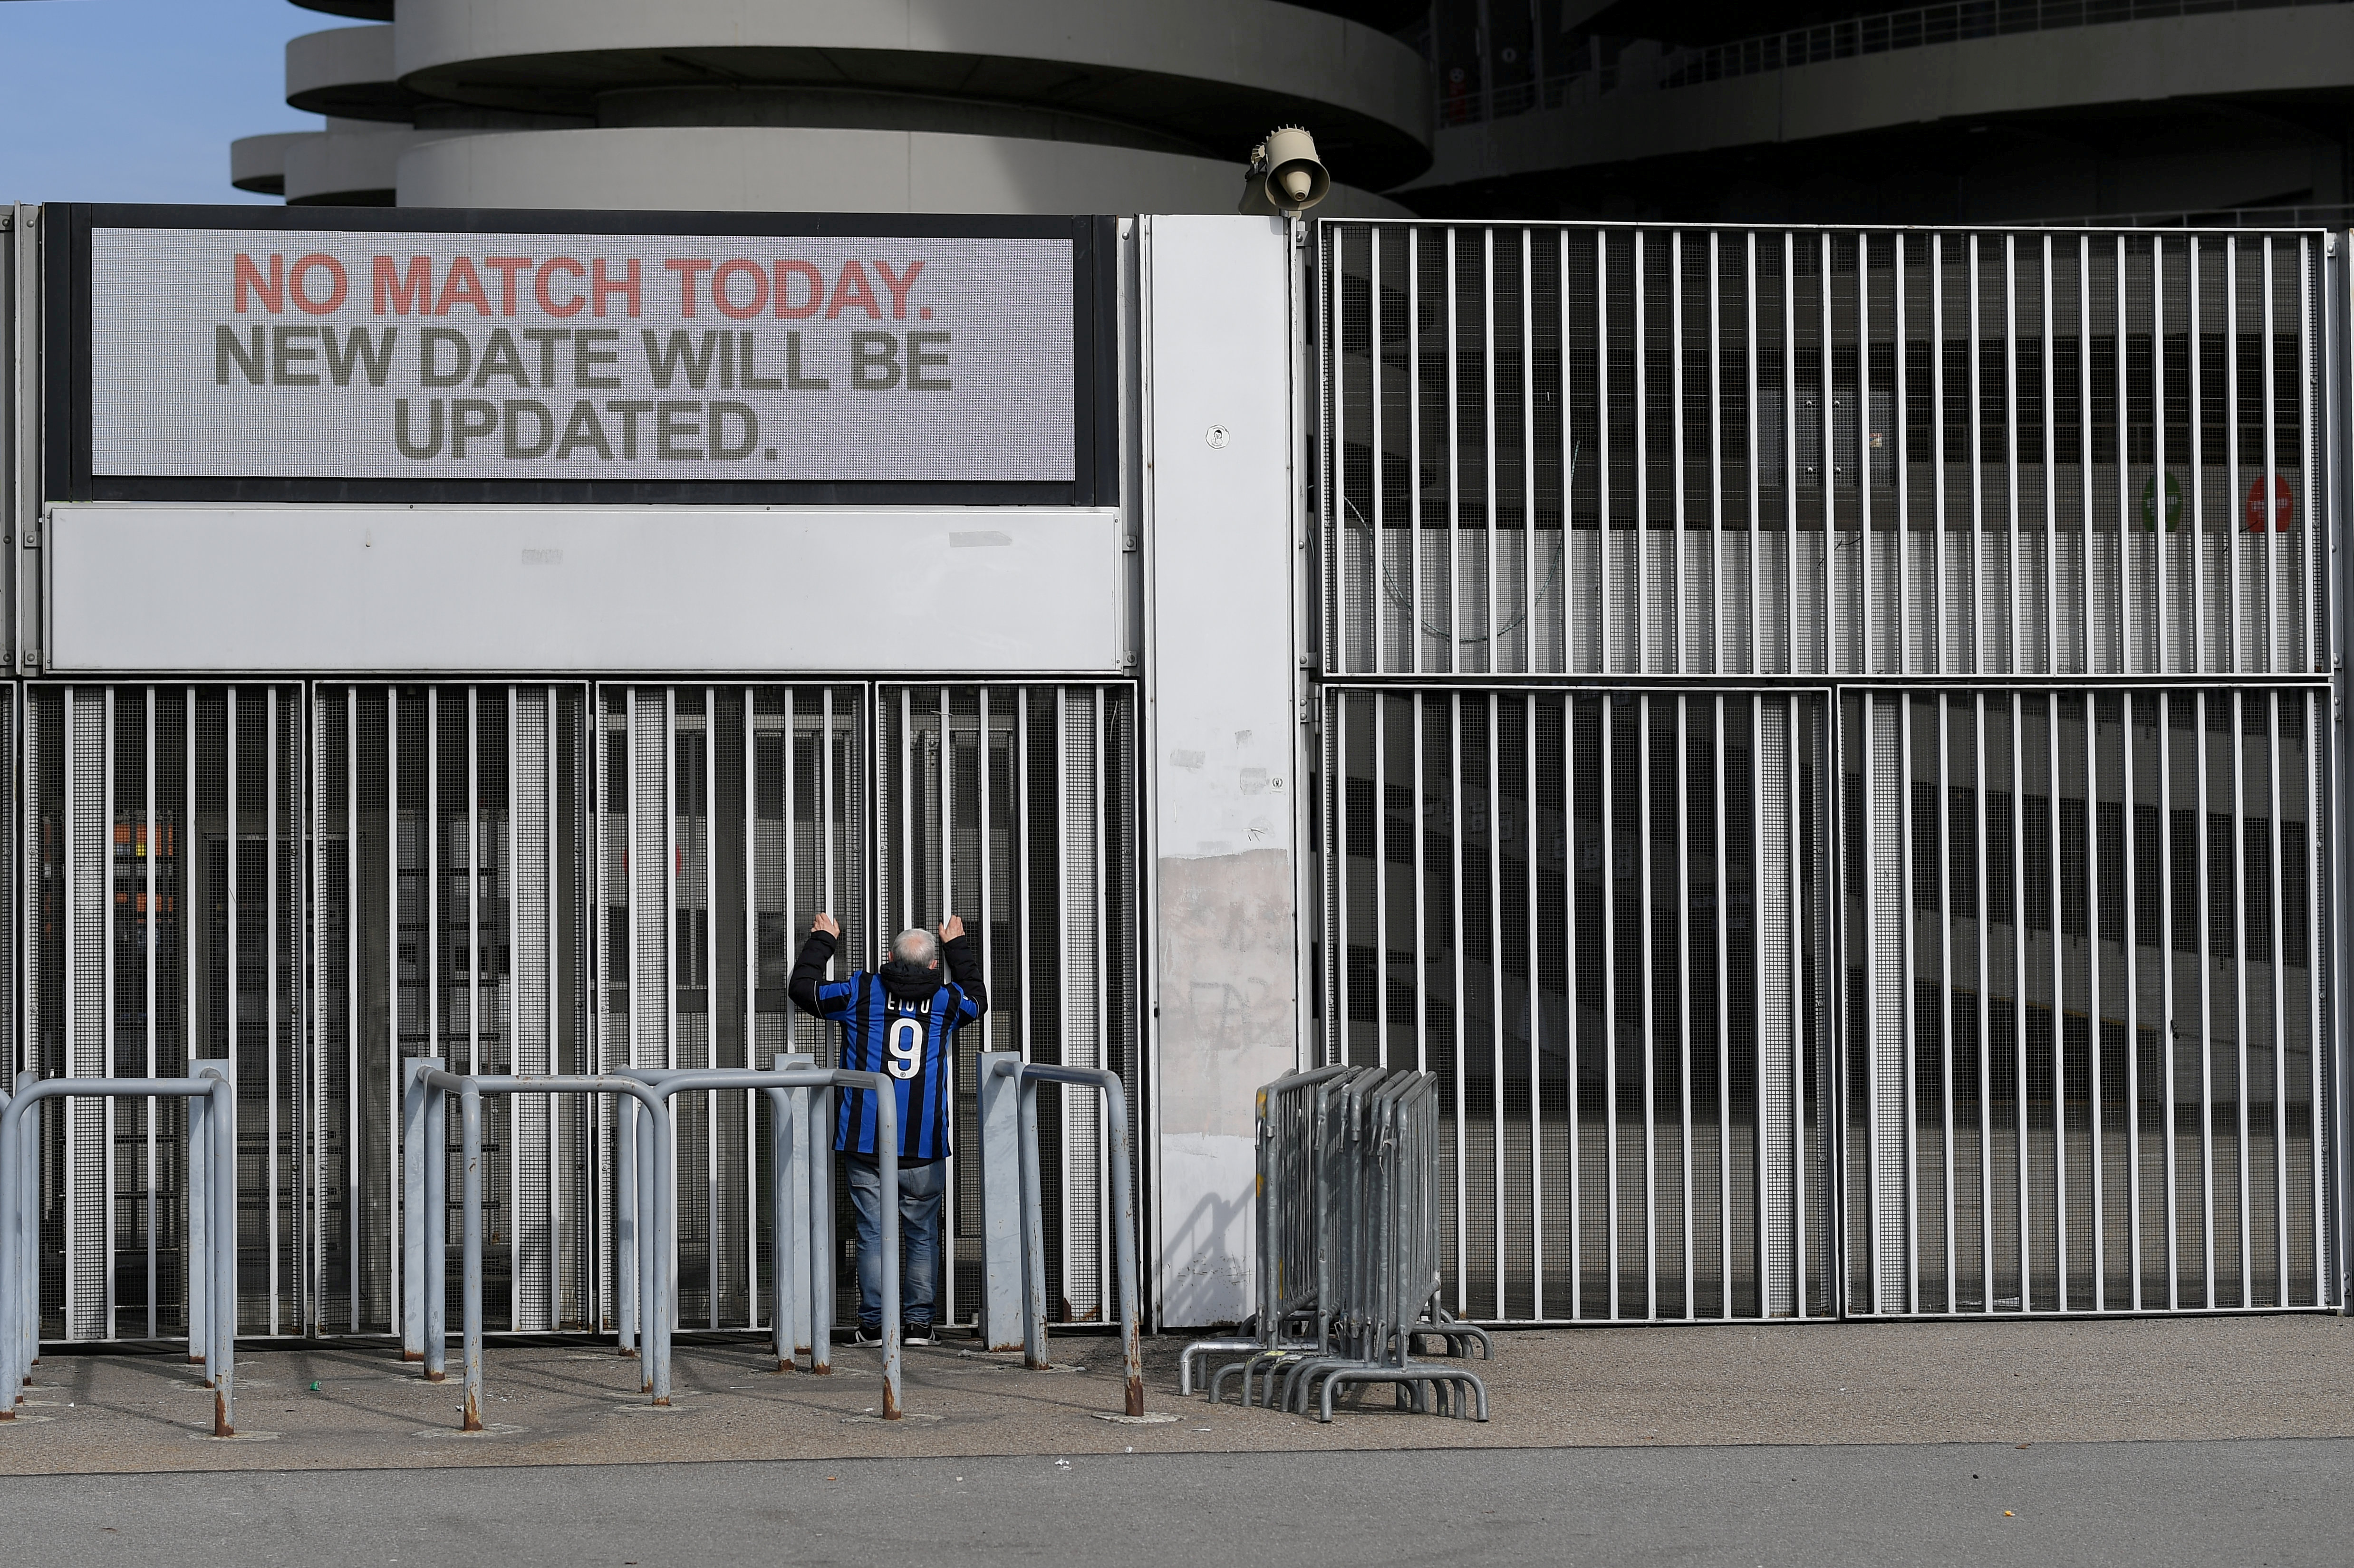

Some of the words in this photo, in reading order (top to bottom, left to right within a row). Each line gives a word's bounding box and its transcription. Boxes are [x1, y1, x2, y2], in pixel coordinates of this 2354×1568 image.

[234, 253, 347, 315] NO
[373, 256, 639, 317] MATCH
[665, 258, 932, 320] TODAY.
[215, 325, 397, 386] NEW
[421, 327, 621, 389] DATE
[642, 329, 829, 390] WILL
[851, 331, 951, 391] BE
[395, 399, 777, 461] UPDATED.
[888, 1018, 923, 1079] 9
